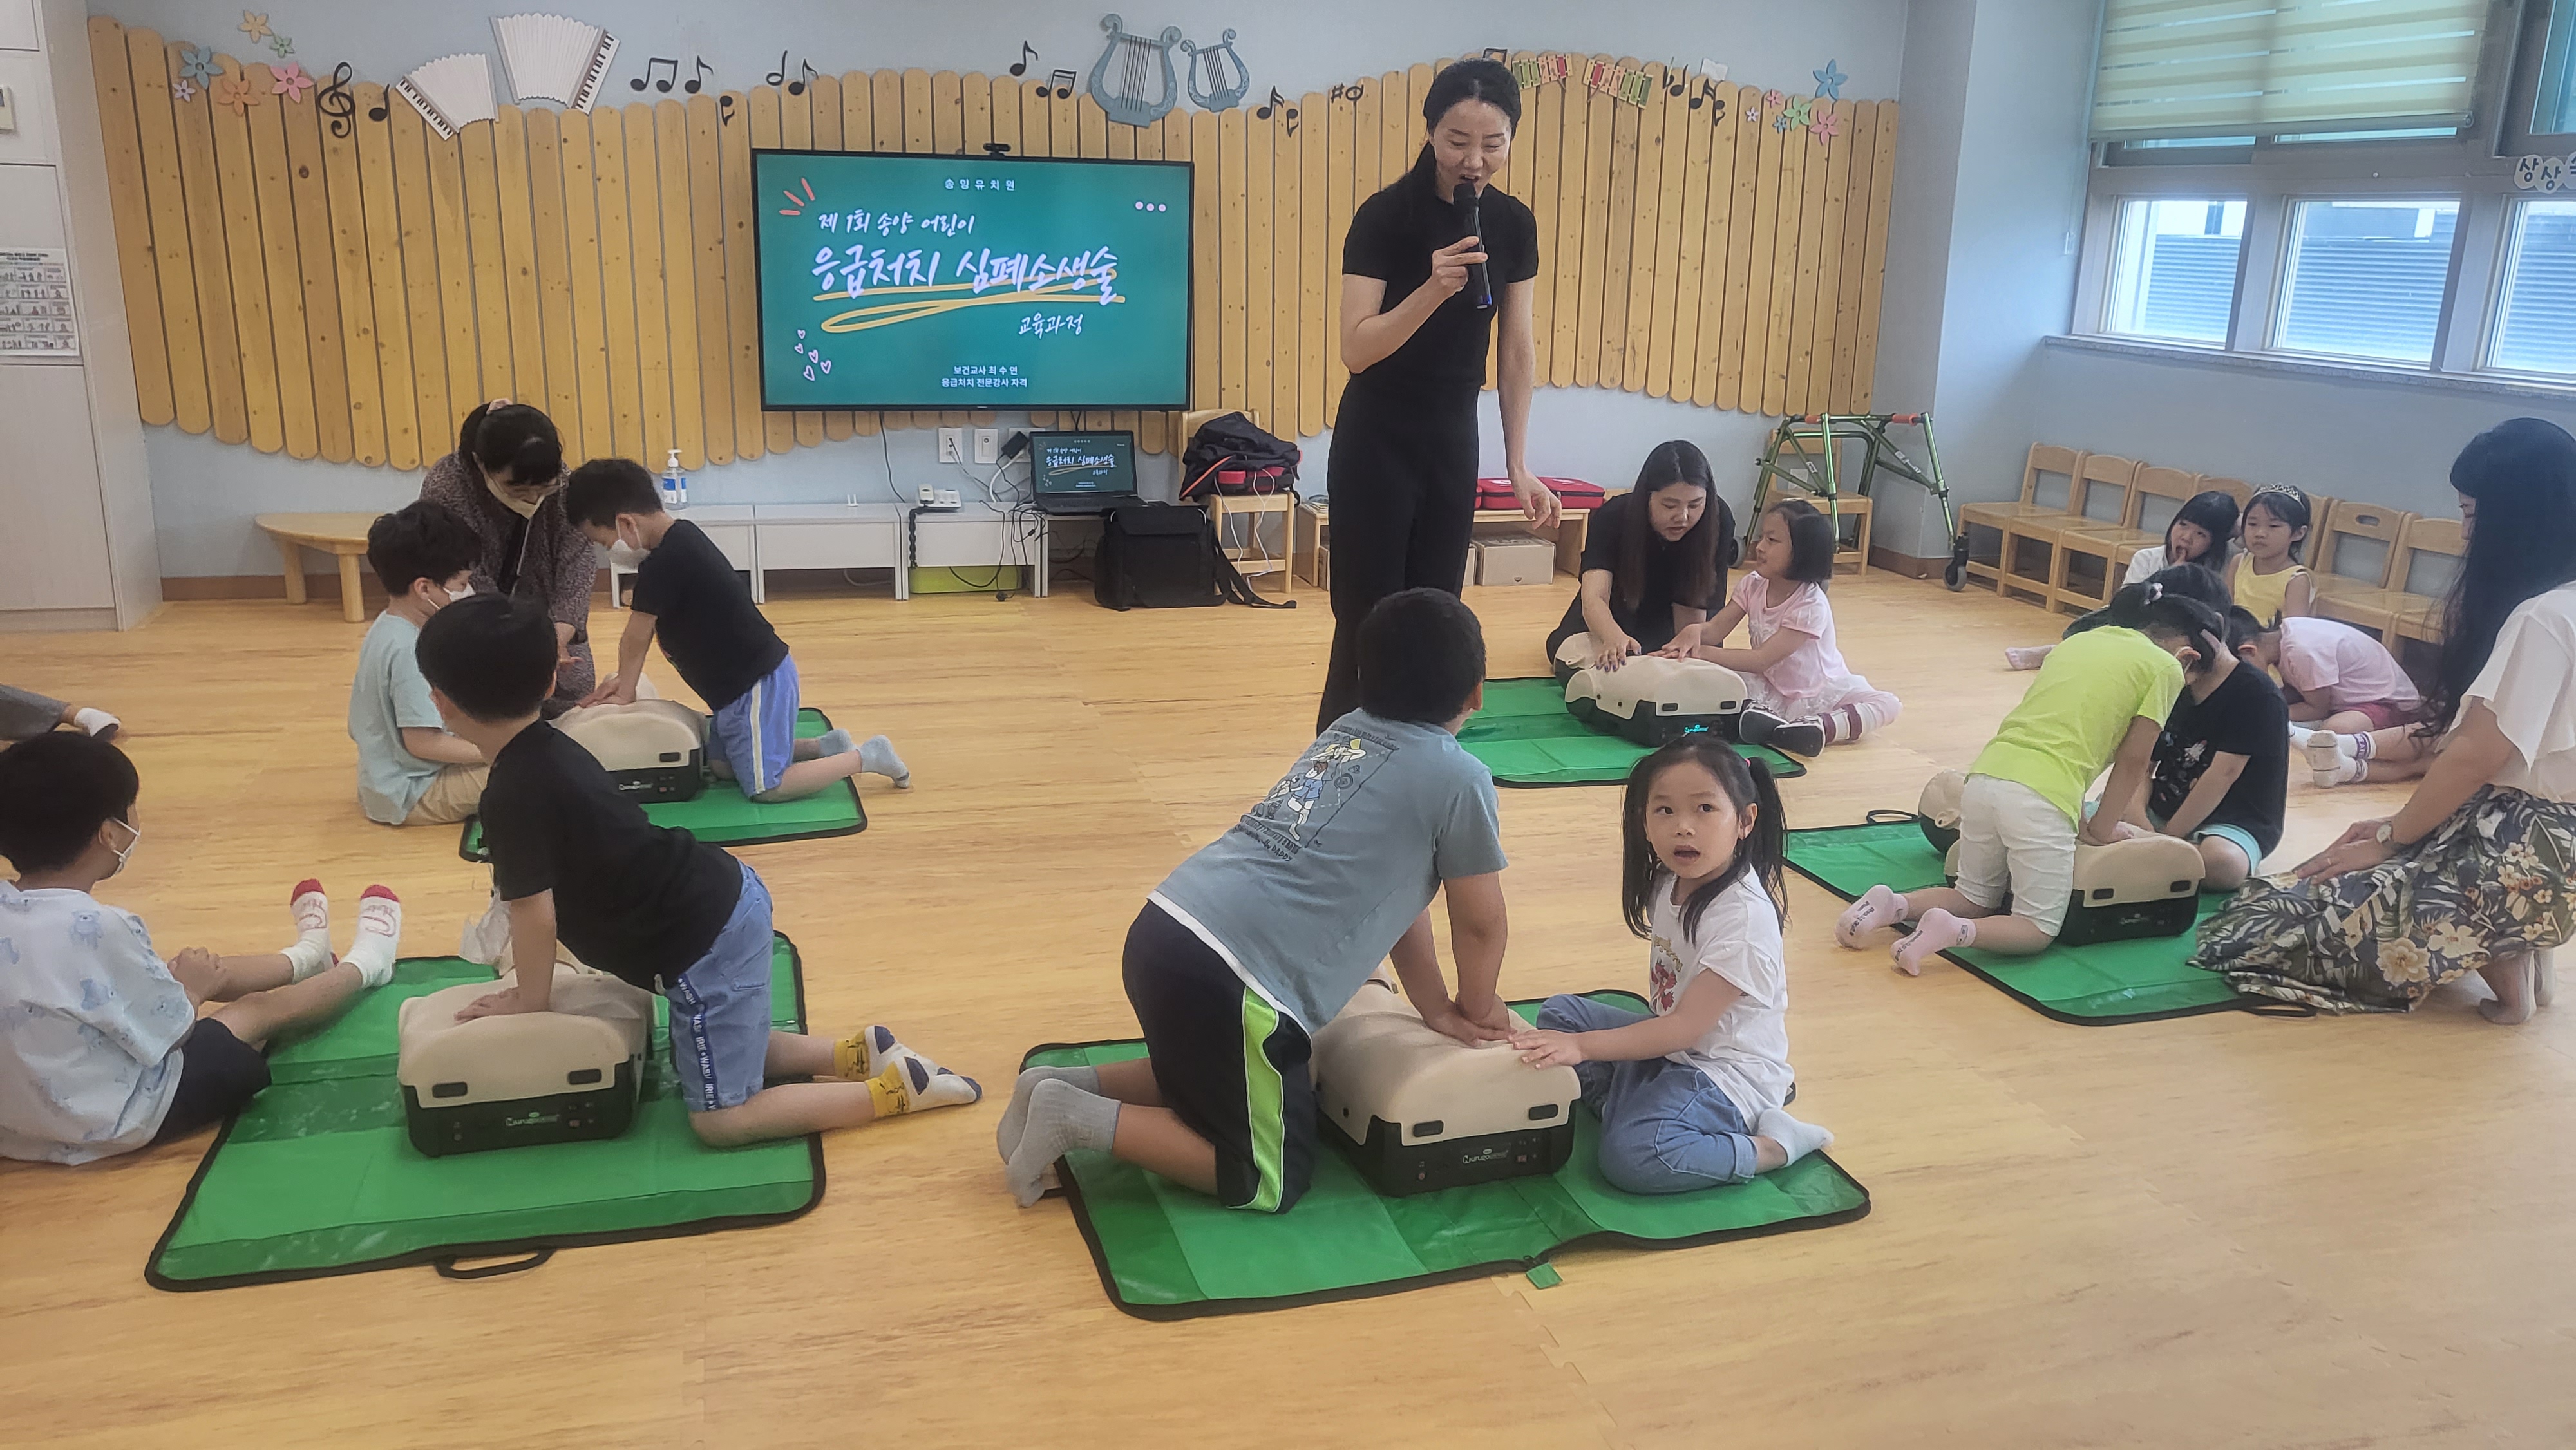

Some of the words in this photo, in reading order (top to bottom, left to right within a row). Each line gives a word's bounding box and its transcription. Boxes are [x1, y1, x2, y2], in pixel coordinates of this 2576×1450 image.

[818, 212, 838, 234] 제
[846, 209, 871, 234] 1회
[877, 211, 914, 237] 송양
[920, 213, 975, 238] 어린이
[811, 244, 941, 299] 응급처치
[956, 245, 1118, 306] 심폐소생술
[1018, 312, 1083, 339] 교육과정
[953, 366, 986, 375] 보건교사
[942, 377, 974, 388] 응급처치
[976, 377, 1009, 388] 전문강사
[1011, 377, 1027, 388] 자격
[1046, 455, 1075, 468] 응급처치
[1078, 453, 1115, 468] 심폐소생술
